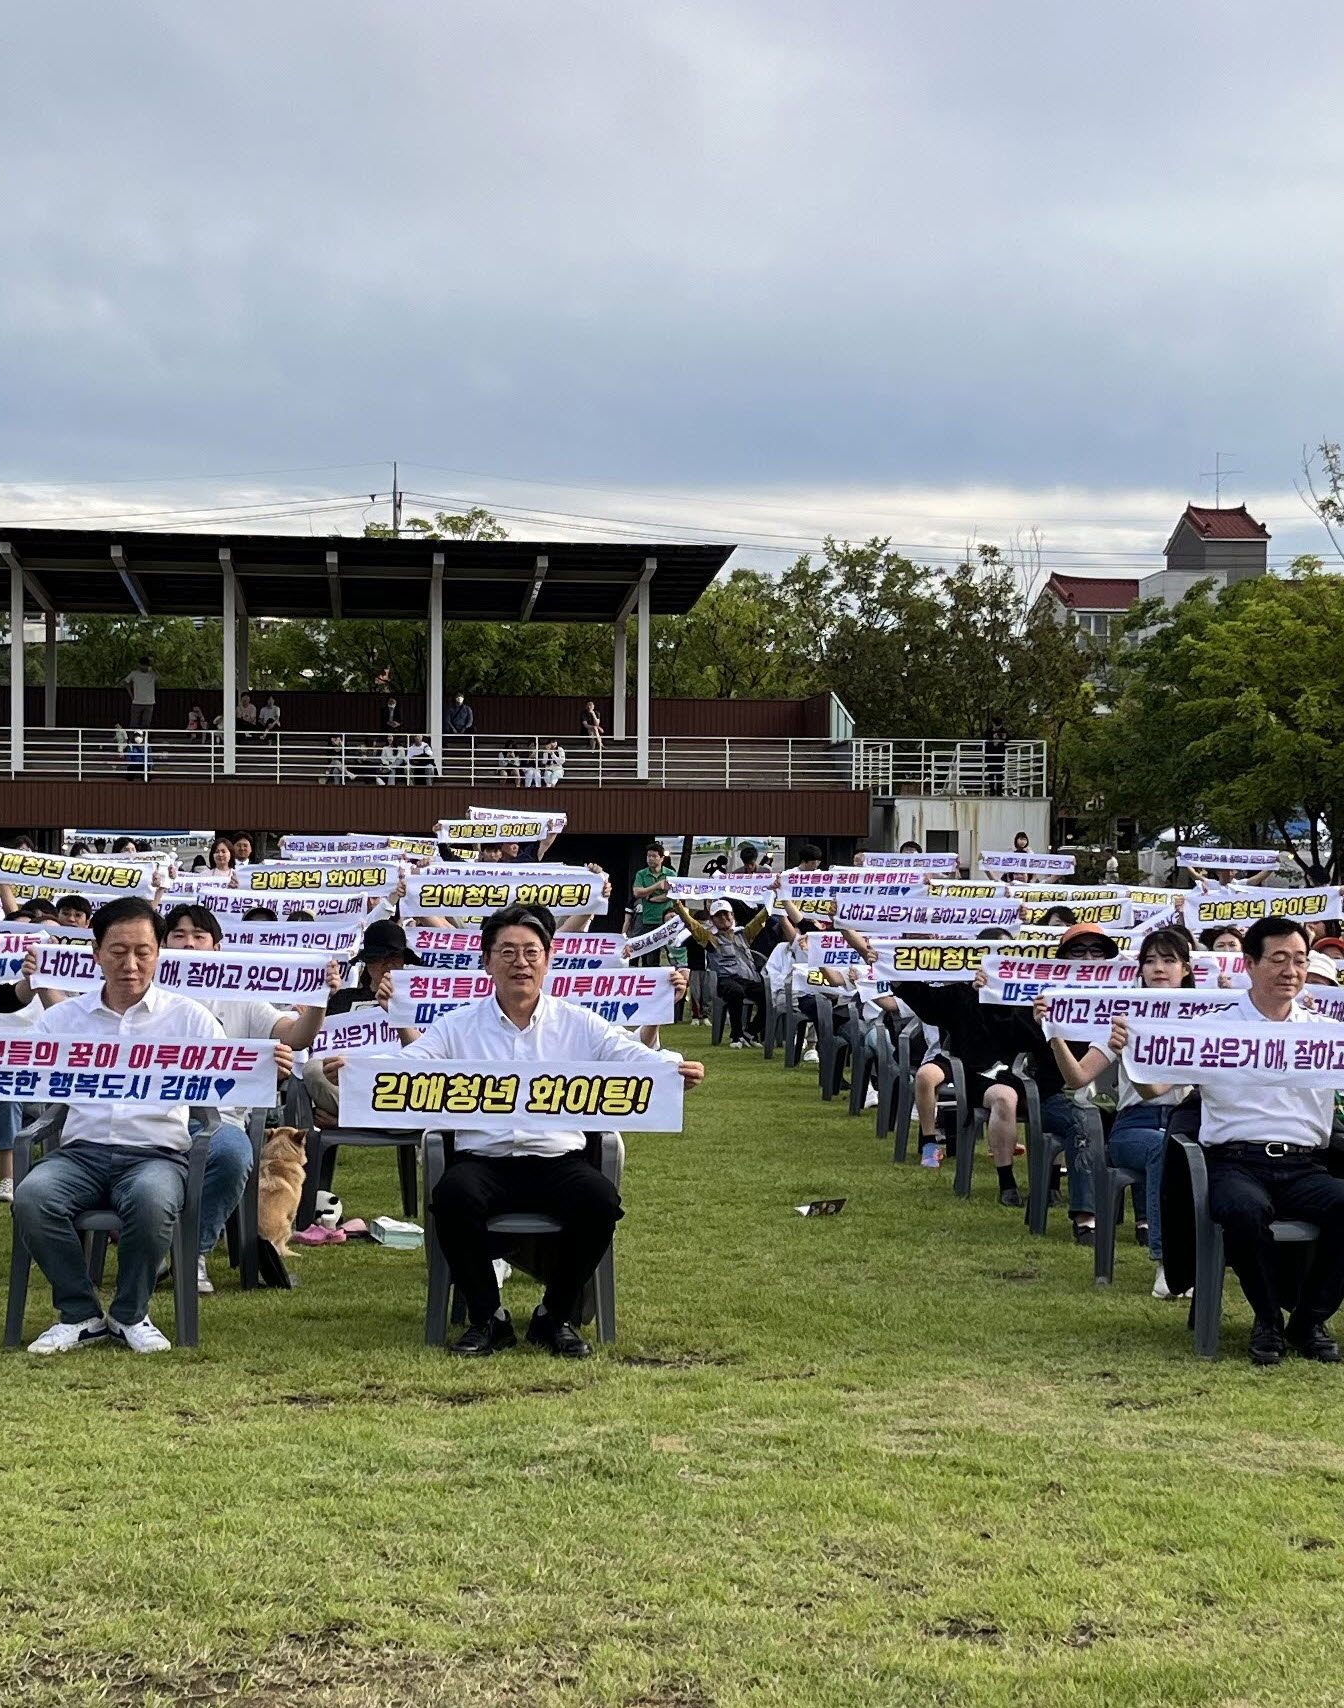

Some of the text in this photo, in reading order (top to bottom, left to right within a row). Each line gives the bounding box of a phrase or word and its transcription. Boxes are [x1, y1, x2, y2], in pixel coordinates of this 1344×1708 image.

[449, 824, 497, 838] 김해청년
[68, 862, 143, 887] 화이팅!
[251, 868, 385, 890] 김해청년 화이팅!
[420, 885, 591, 907] 김해청년 화이팅!
[1199, 894, 1327, 921] 김해청년 화이팅!
[839, 904, 876, 921] 너하고
[877, 905, 913, 923] 싶은거
[931, 907, 966, 924] 잘하고
[40, 950, 96, 979] 너하고
[159, 959, 182, 989] 해,
[187, 961, 243, 990] 잘하고
[421, 952, 473, 969] 따뜻한
[895, 947, 990, 971] 김해청년
[998, 960, 1111, 981] 청년들의 꿈이
[551, 975, 657, 999] 이루어지는
[332, 1022, 377, 1049] 싶은거
[68, 1043, 118, 1068] 꿈이
[128, 1043, 259, 1072] 이루어지는
[1134, 1036, 1195, 1067] 너하고
[1200, 1037, 1259, 1069] 싶은거
[1265, 1039, 1288, 1072] 해,
[49, 1071, 151, 1100] 행복도시
[160, 1075, 213, 1102] 김해
[372, 1072, 654, 1115] 김해청년 화이팅!
